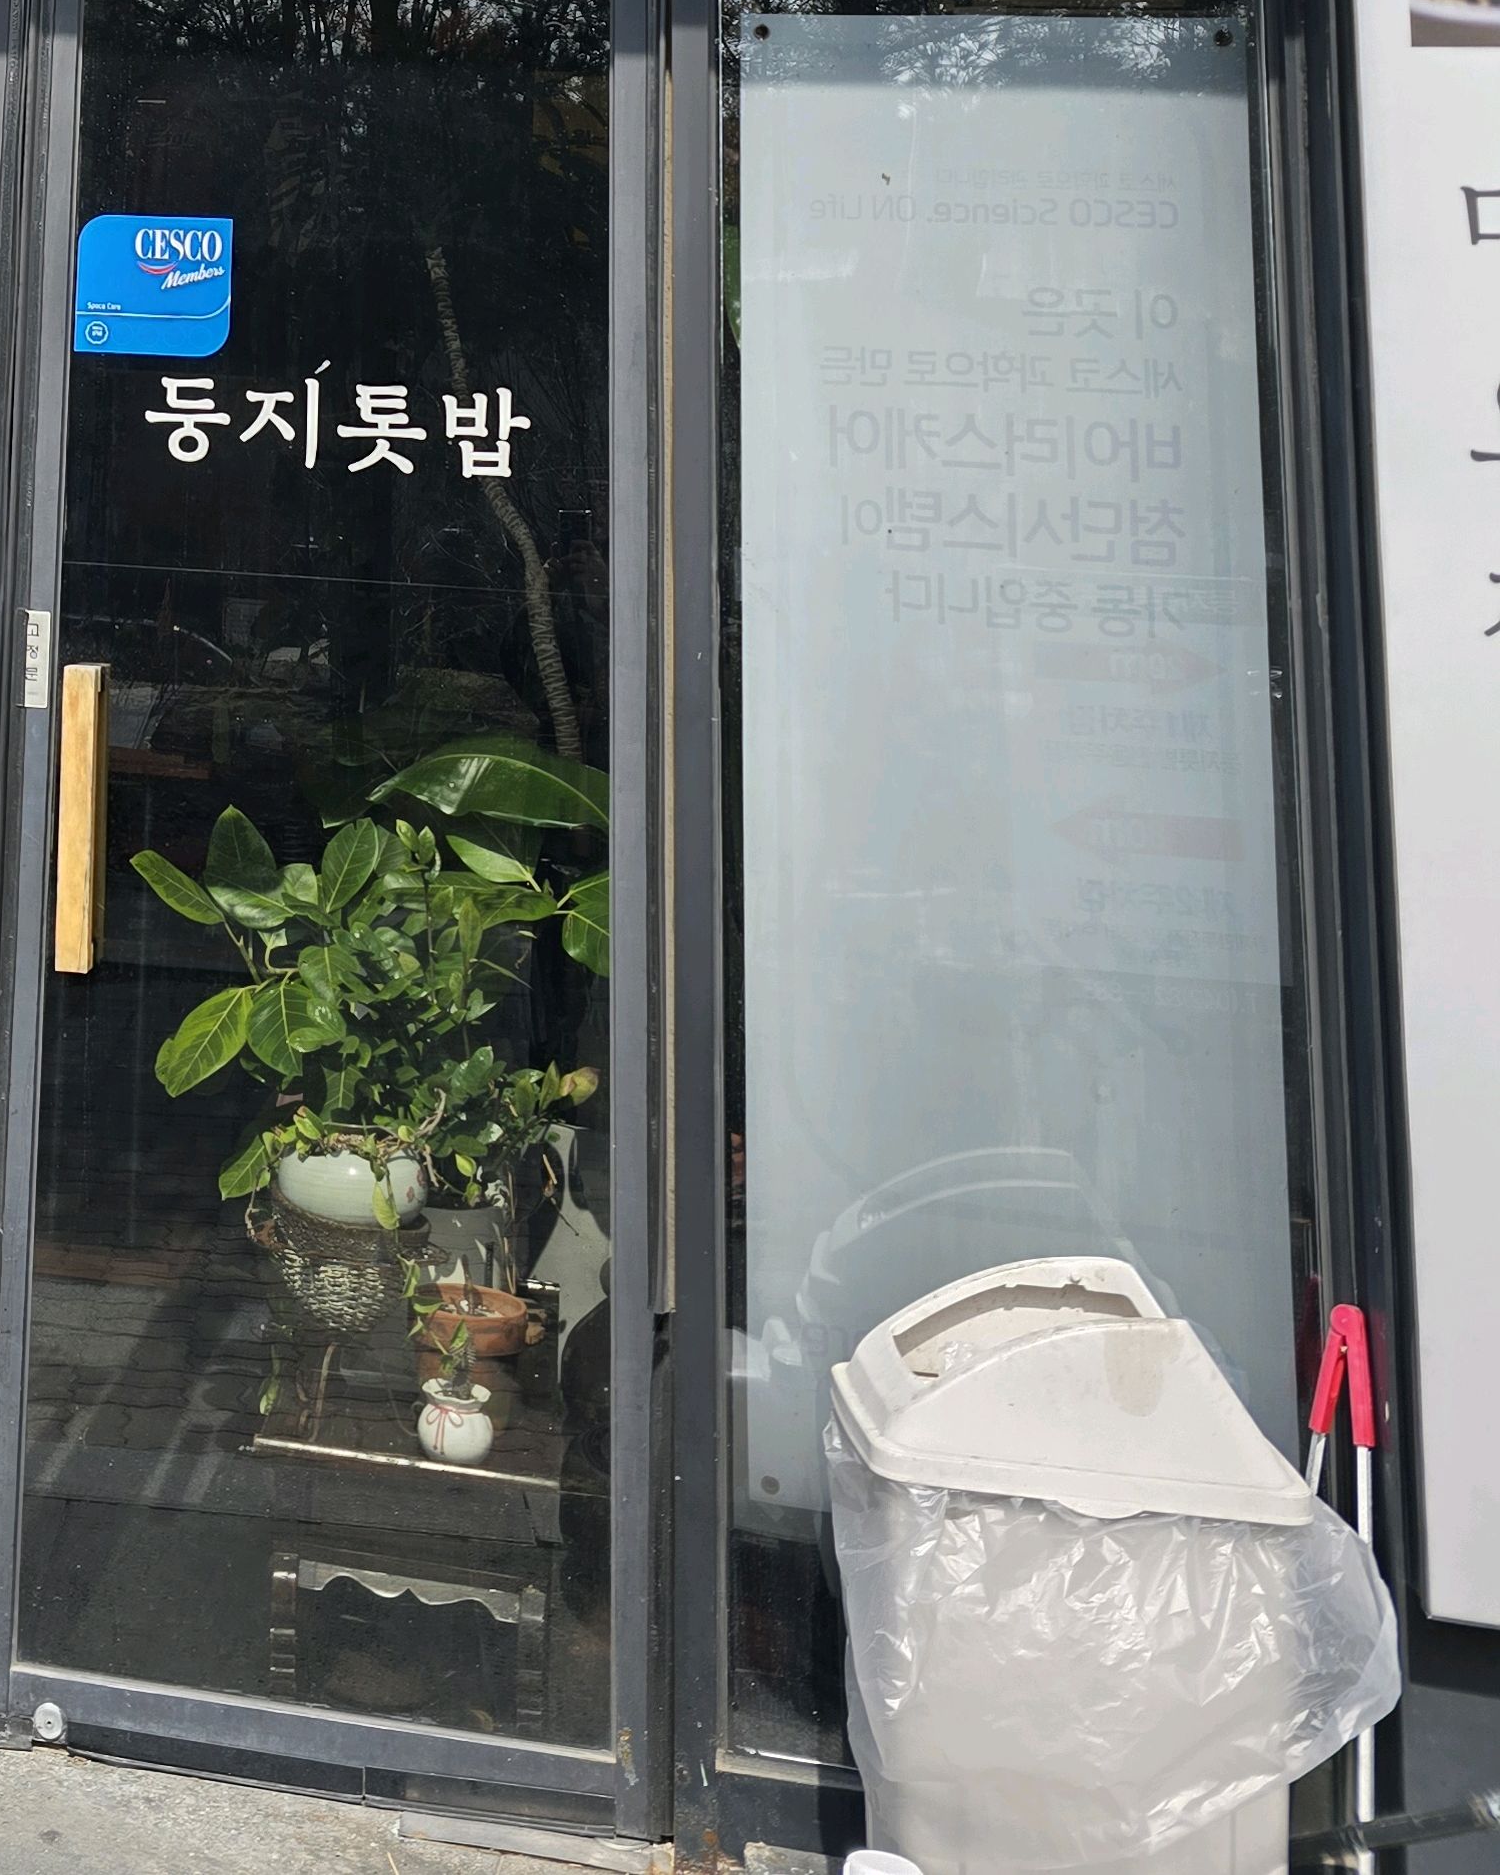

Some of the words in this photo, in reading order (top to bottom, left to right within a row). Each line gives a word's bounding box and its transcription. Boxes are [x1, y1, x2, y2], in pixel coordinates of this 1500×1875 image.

[135, 229, 222, 261] CESCO
[161, 264, 225, 290] Members
[143, 363, 531, 479] 둥지톳밥
